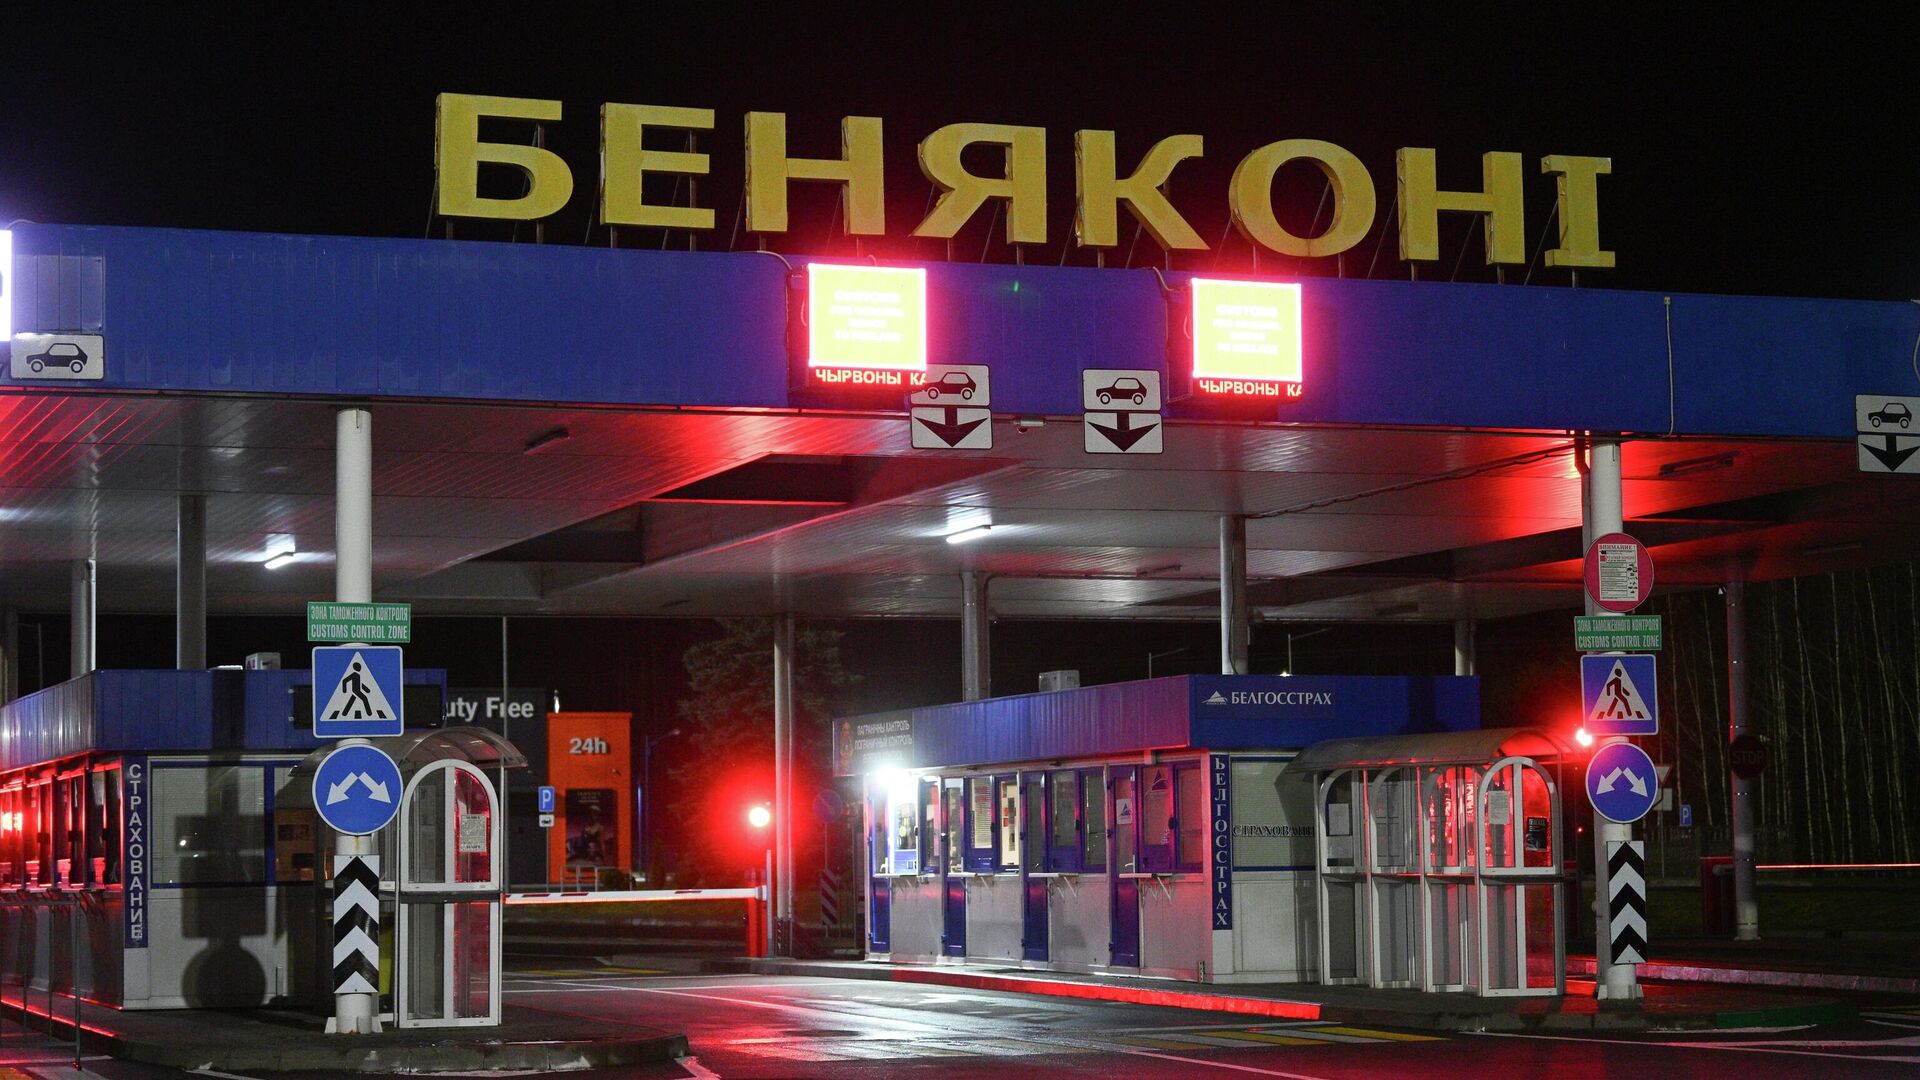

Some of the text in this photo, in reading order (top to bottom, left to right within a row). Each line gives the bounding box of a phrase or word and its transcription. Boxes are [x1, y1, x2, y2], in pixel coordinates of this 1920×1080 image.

[434, 92, 1616, 269] БЕНЯКОНІ
[815, 368, 902, 385] ЧЫРВОНЫ
[1199, 379, 1279, 396] ЧЫРВОНЫ
[310, 605, 408, 621] ЗОНА ТАМОЖЕННОГО КОНТРОЛЯ
[311, 623, 408, 639] CUSTOMS CONTROL ZONE
[1577, 618, 1659, 632] ЗОНА ТАМОЖЕННОГО КОНТРОЛЯ
[1578, 634, 1660, 648] CUSTOMS CONTROL ZONE
[1231, 691, 1332, 705] БЕЛГОССТРАХ
[445, 696, 534, 723] uty Free
[568, 737, 608, 755] 24h
[541, 788, 551, 809] P
[129, 763, 144, 940] СТРАХОВАНИЕ
